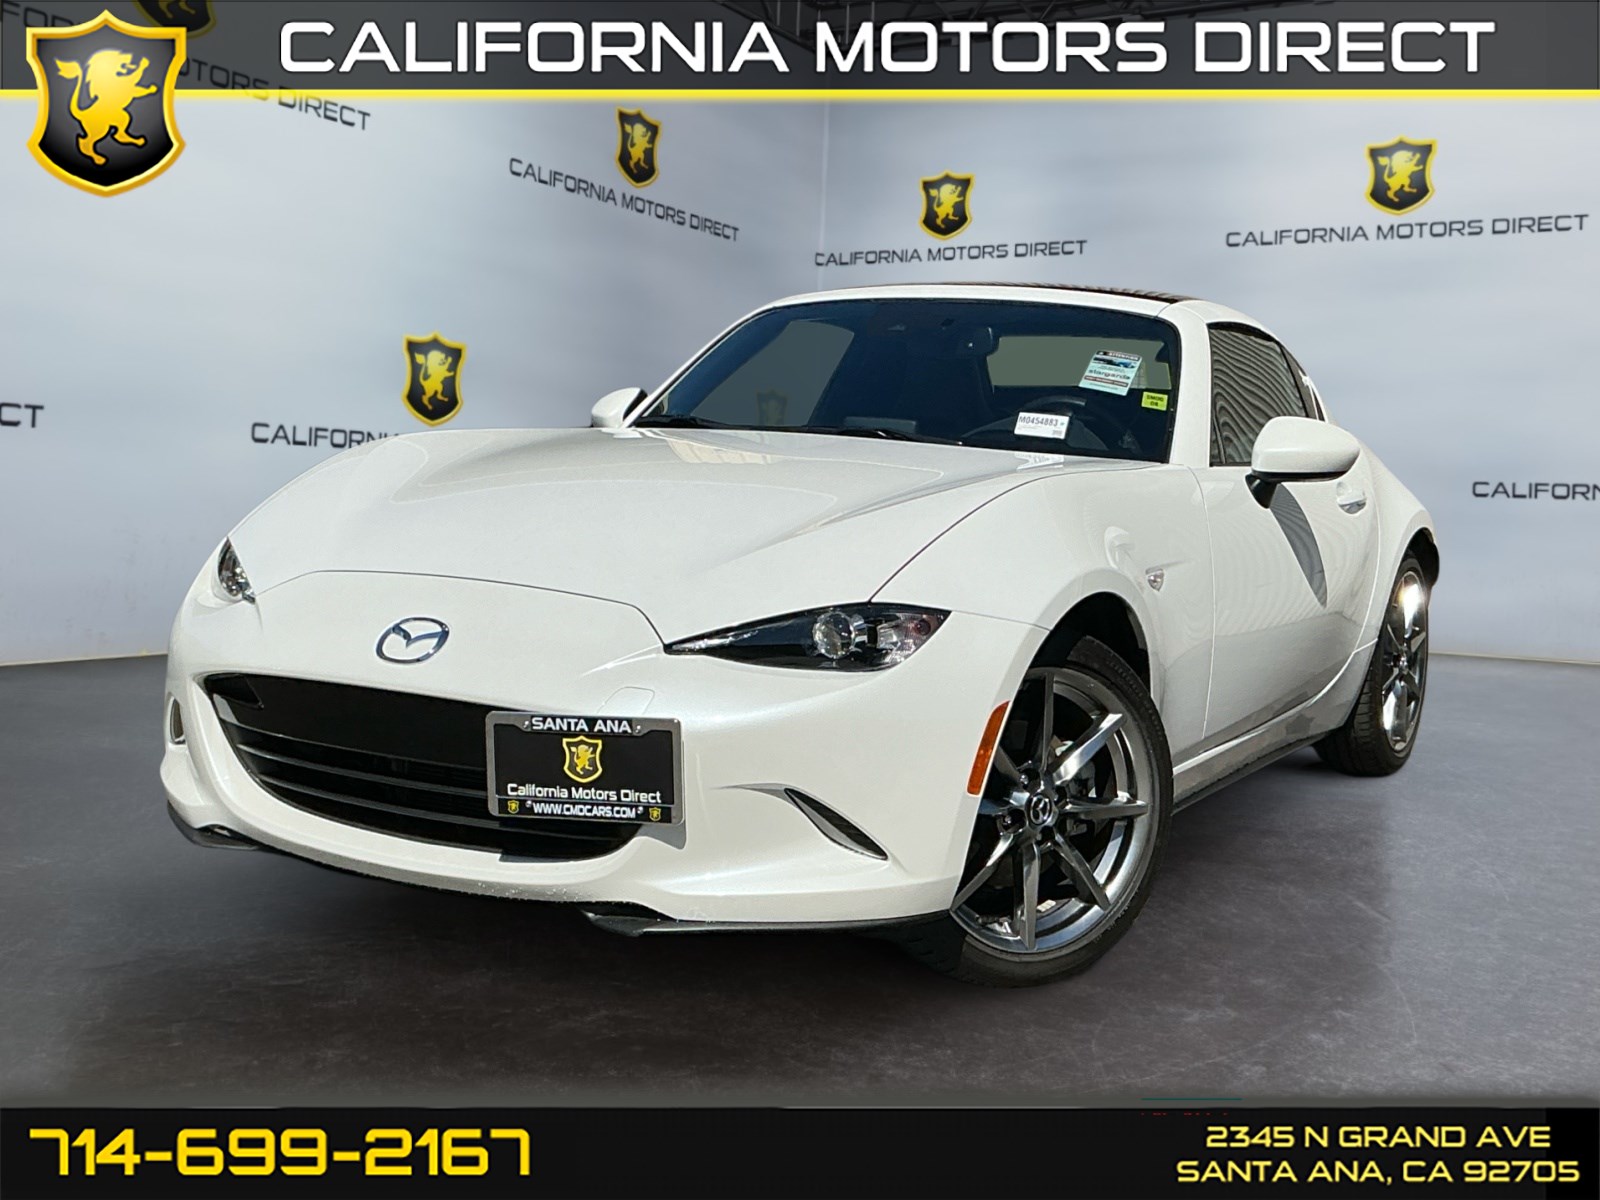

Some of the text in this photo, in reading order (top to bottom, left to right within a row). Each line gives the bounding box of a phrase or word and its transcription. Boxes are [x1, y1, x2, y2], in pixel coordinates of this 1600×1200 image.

[278, 86, 371, 130] DIRECT
[509, 157, 740, 242] CALIFORNIA MOTORS DIRECT
[1225, 214, 1589, 247] CALIFORNIA MOTORS DIRECT
[814, 240, 1088, 267] CALIFORNIA MOTORS DIRECT
[531, 716, 632, 734] SANTA ANA
[507, 783, 662, 804] California Motors Direct
[532, 802, 636, 819] WWW.CMDCARS.COM
